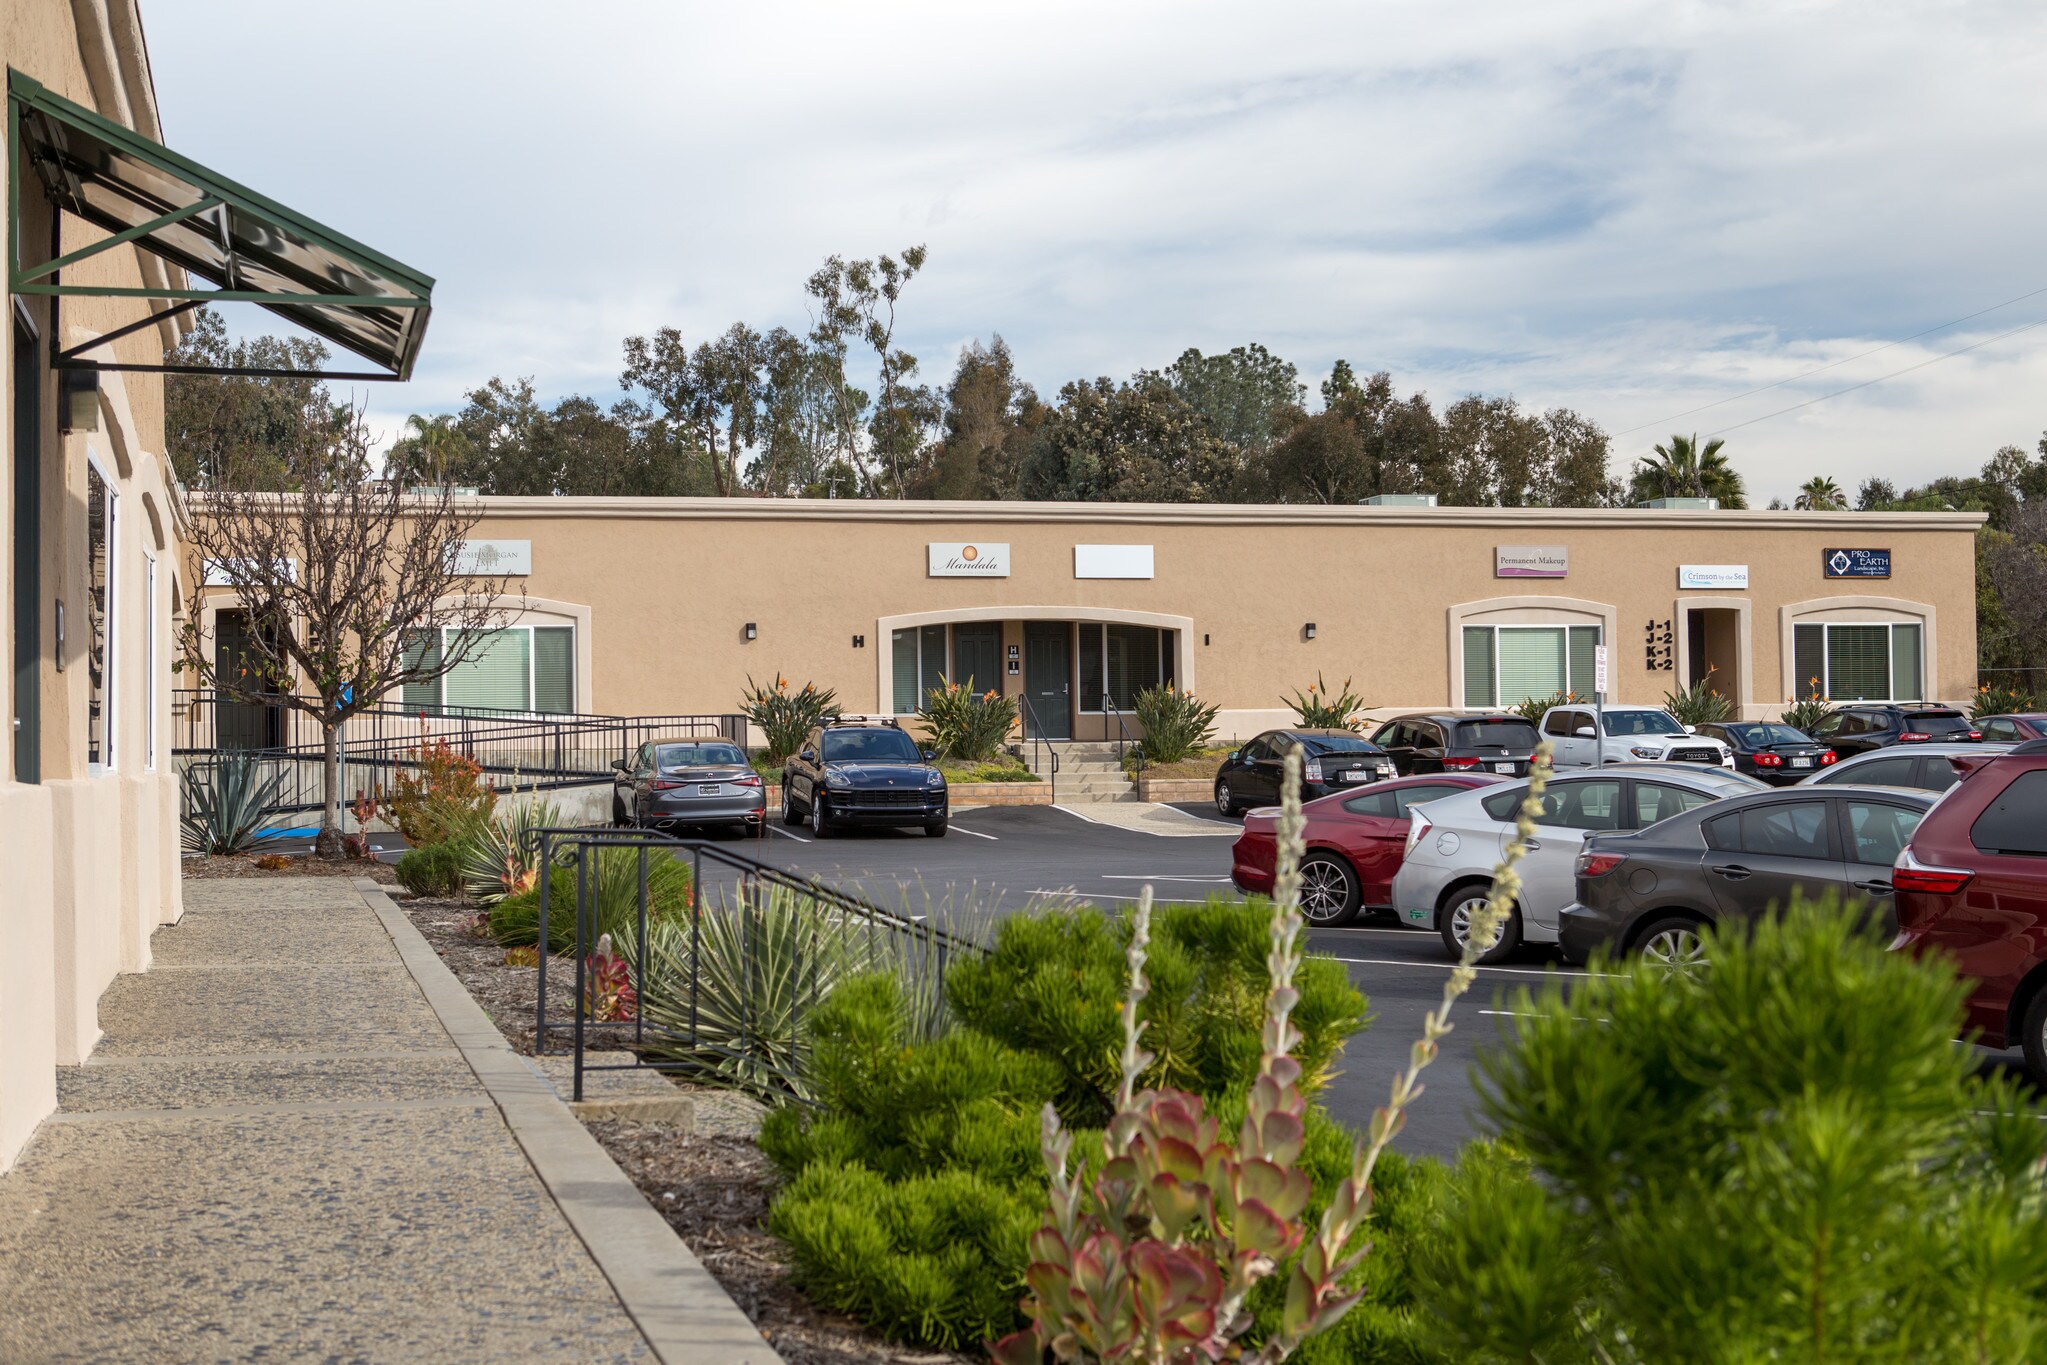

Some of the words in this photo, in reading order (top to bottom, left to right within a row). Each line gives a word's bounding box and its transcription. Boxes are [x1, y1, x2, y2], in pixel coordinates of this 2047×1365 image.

[1851, 550, 1870, 558] PRO
[933, 557, 997, 570] Mandala
[1500, 556, 1537, 564] Permanent
[1539, 556, 1566, 566] Makeup
[1860, 558, 1889, 566] EARTH
[1646, 619, 1671, 631] J-1
[852, 635, 864, 648] H
[1646, 632, 1673, 643] J-2
[1010, 646, 1017, 654] H
[1646, 645, 1671, 657] K-1
[1646, 658, 1673, 670] K-2
